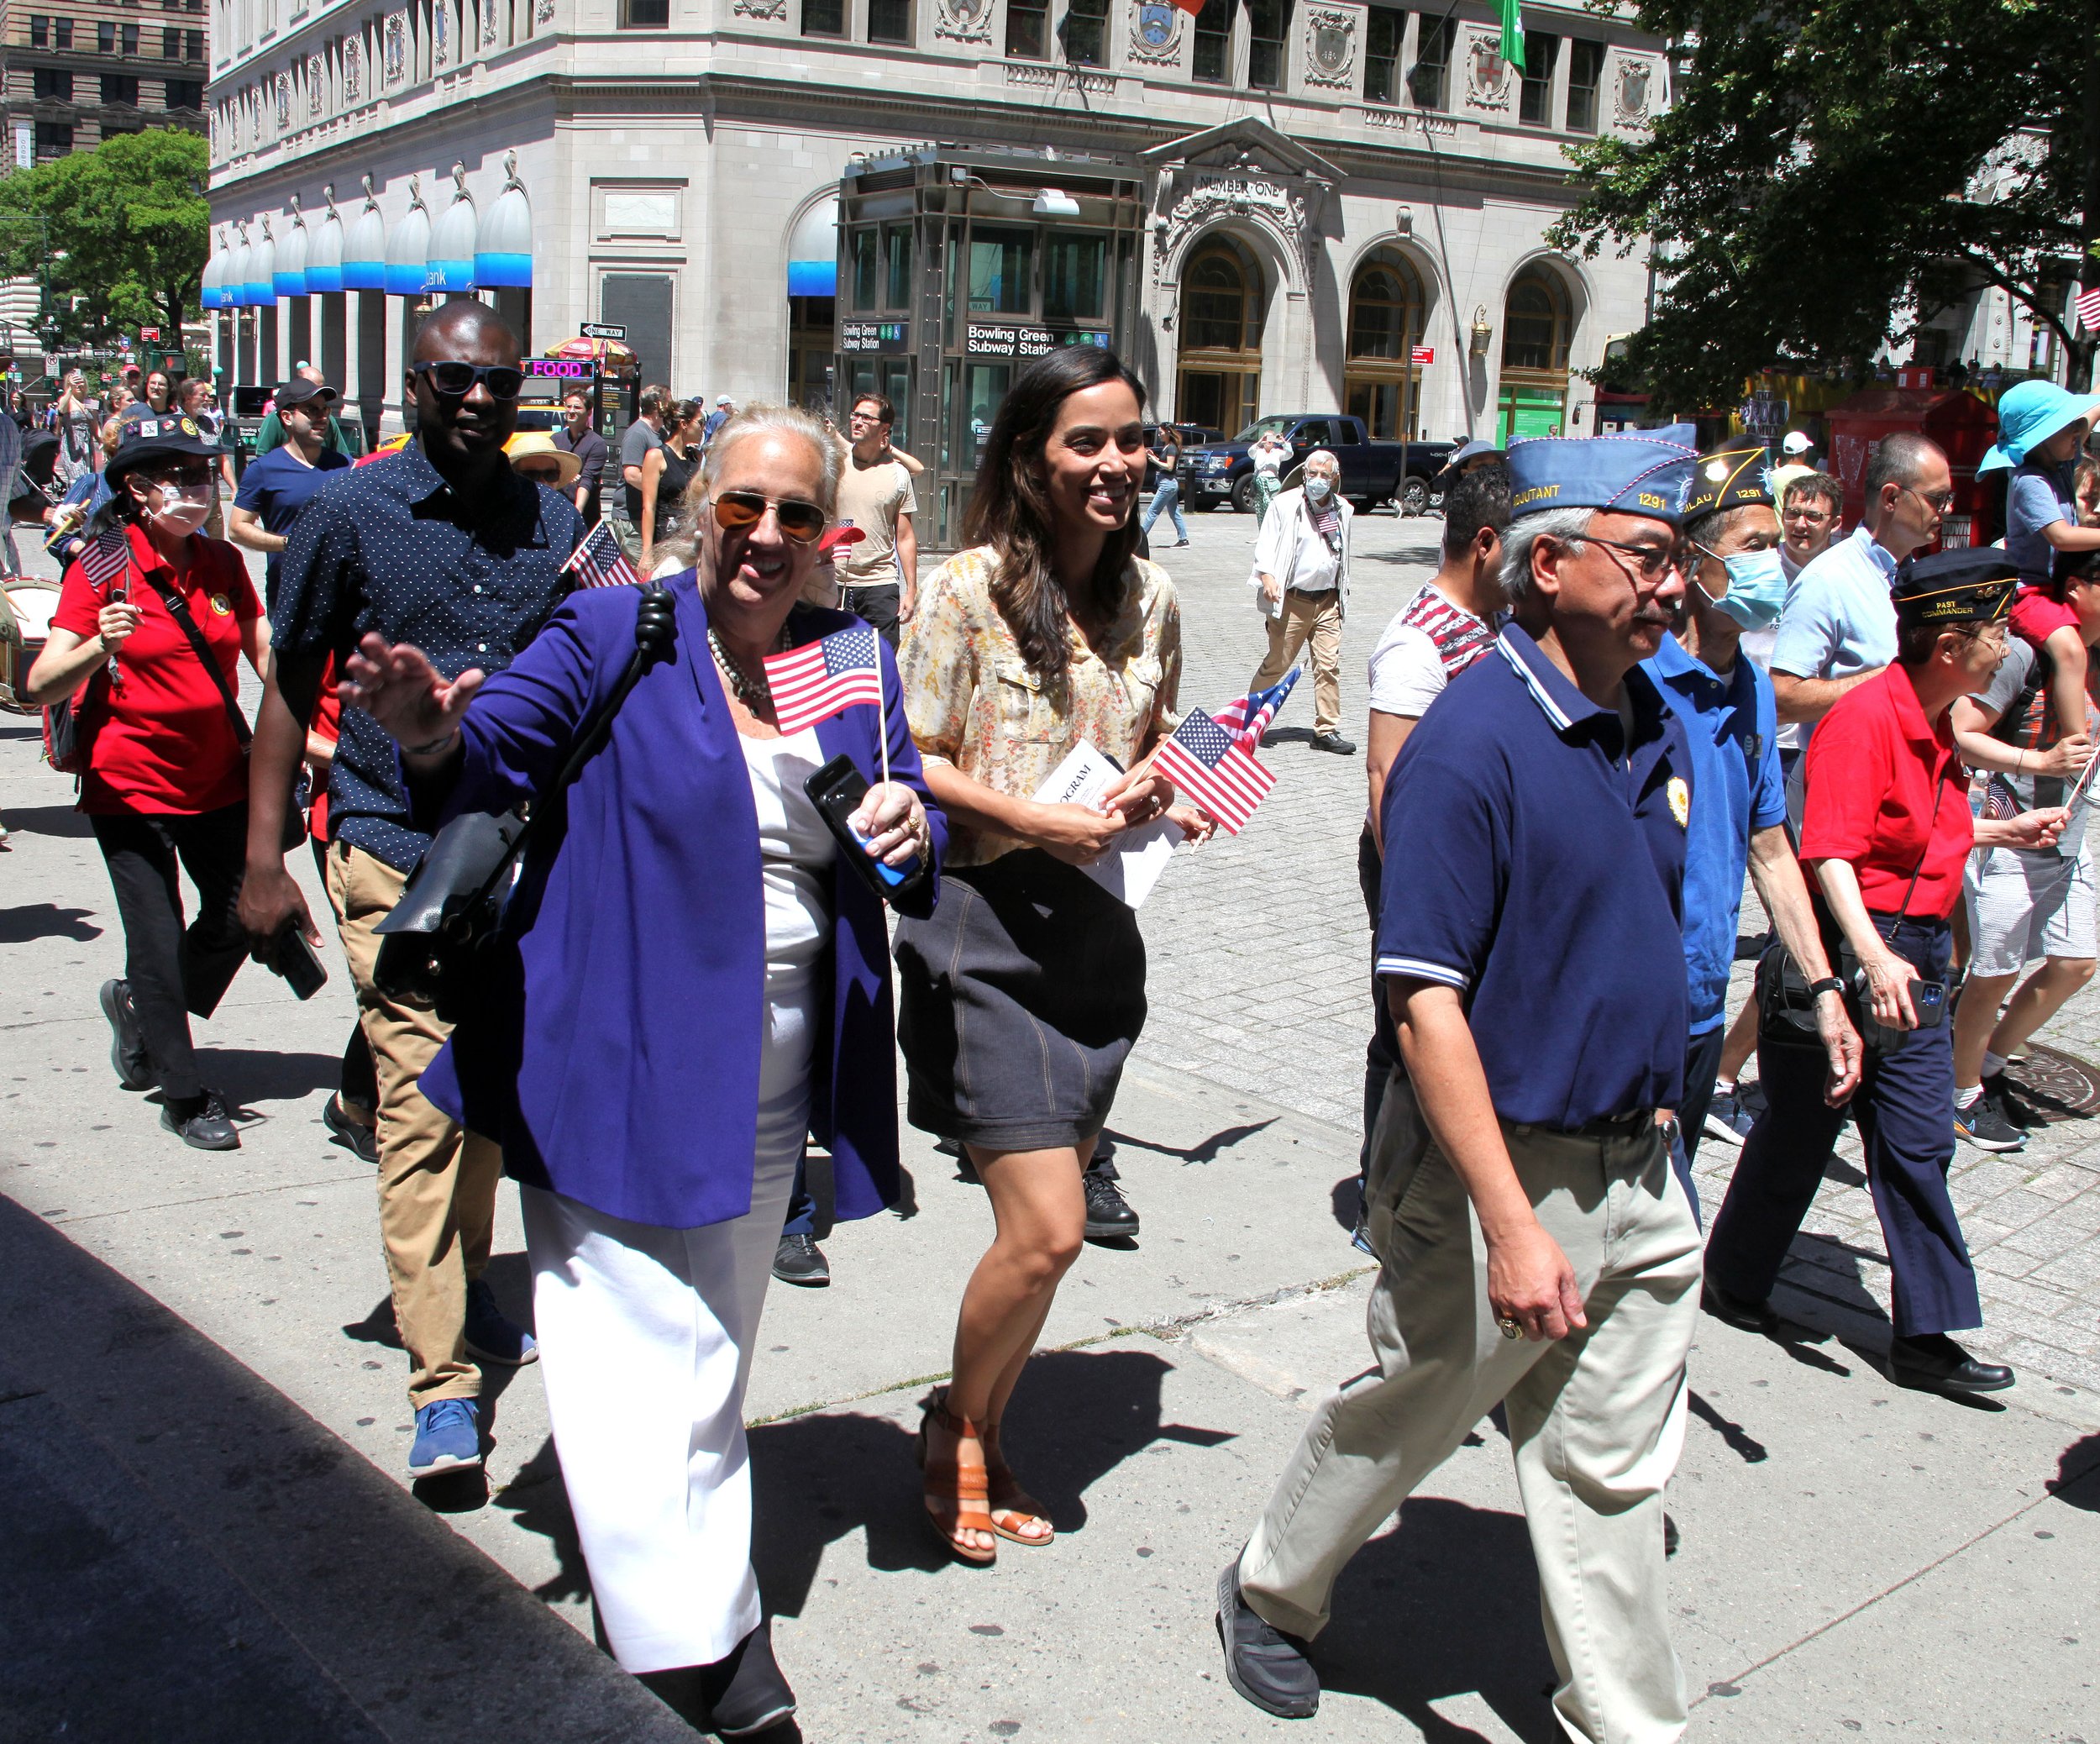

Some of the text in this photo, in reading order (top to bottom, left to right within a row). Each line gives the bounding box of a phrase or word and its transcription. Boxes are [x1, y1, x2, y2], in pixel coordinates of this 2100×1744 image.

[1200, 176, 1279, 197] NUMBER ONE
[972, 302, 989, 311] WAY
[587, 327, 601, 335] ONE
[843, 324, 860, 338] Bowling
[861, 324, 877, 336] Green
[968, 326, 1015, 342] Bowling
[1019, 328, 1054, 342] Green
[843, 337, 879, 351] Subway Station
[968, 339, 1057, 355] Subway Statio
[533, 361, 581, 377] FOOD
[1756, 391, 1774, 401] THE
[1735, 489, 1761, 499] 1291
[1638, 492, 1667, 512] 1291
[1941, 523, 1971, 535] DOWN
[1941, 536, 1970, 549] TOWN
[1936, 601, 1956, 609] PAST
[1922, 607, 1973, 618] COMMANDER
[1059, 763, 1092, 803] OGRAM
